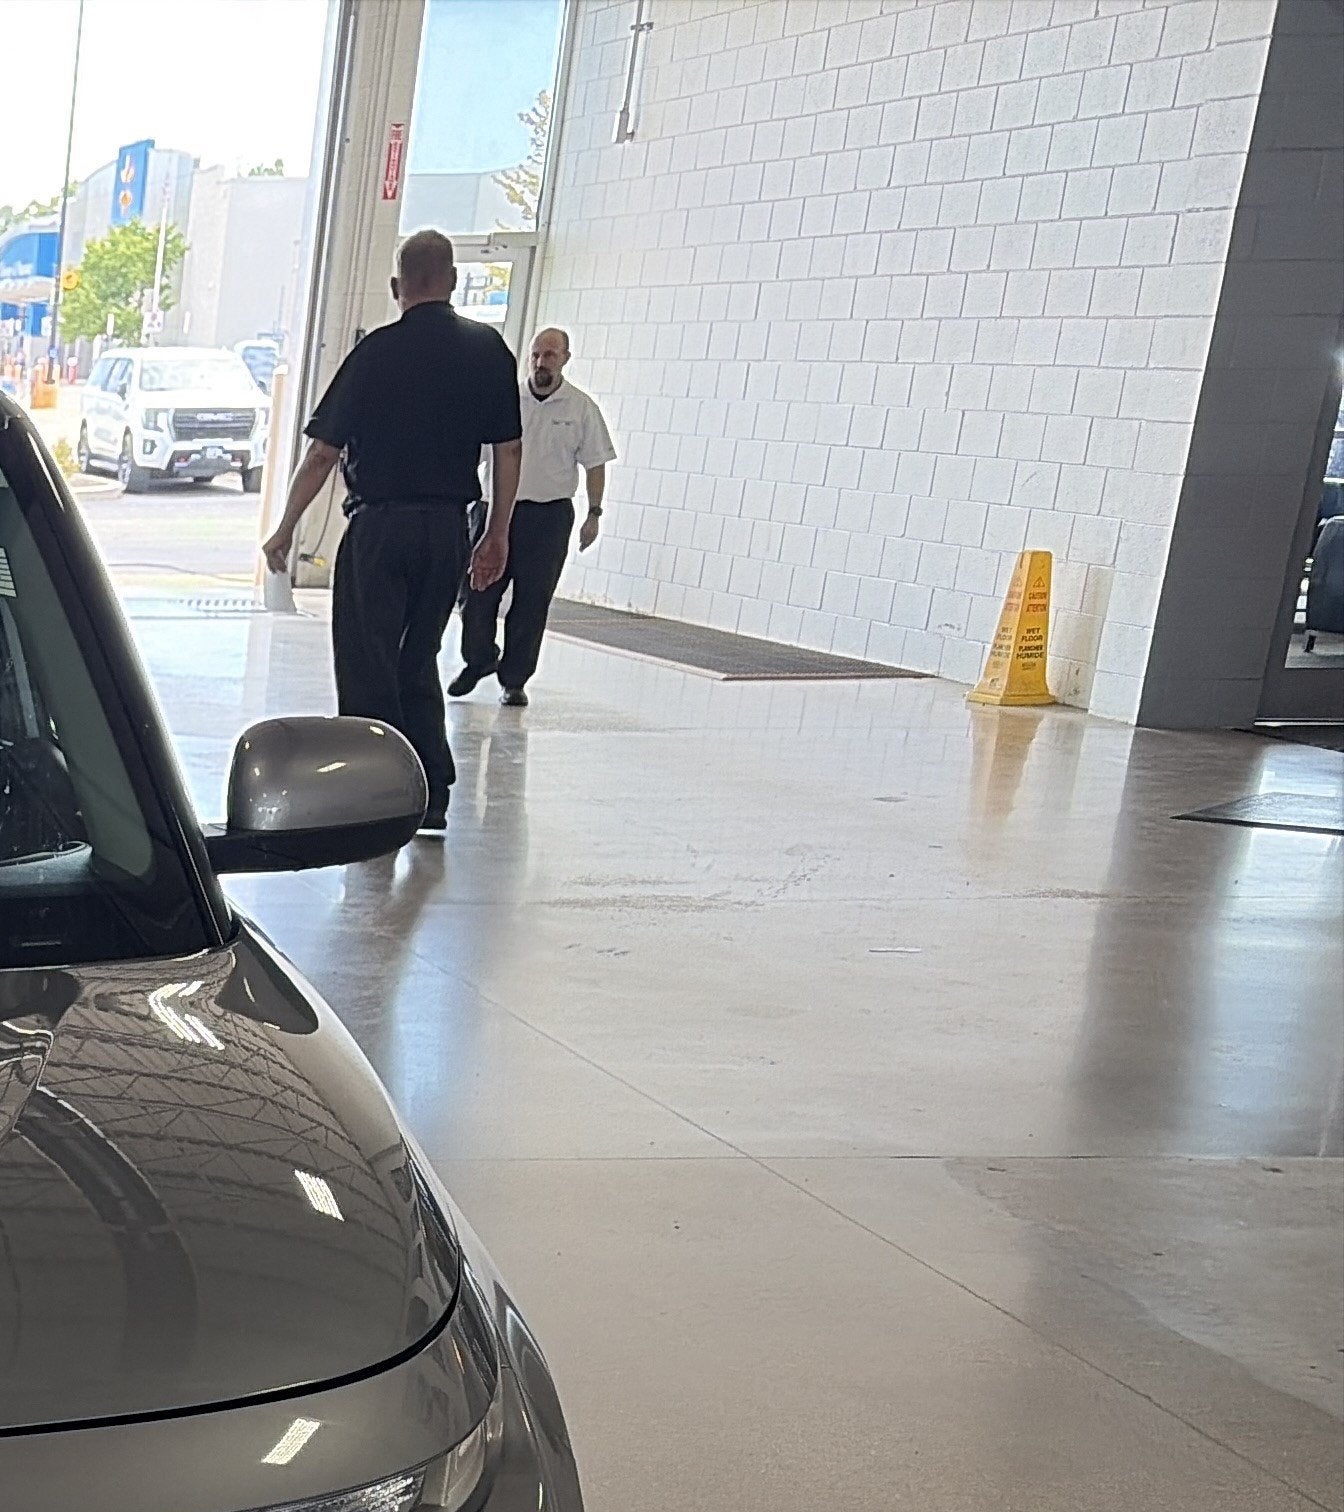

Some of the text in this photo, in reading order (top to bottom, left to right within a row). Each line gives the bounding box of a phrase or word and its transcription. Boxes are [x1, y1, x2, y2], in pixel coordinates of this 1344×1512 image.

[1025, 627, 1041, 635] WET
[1021, 635, 1044, 643] FLOOR
[1016, 652, 1044, 660] HUMIDE
